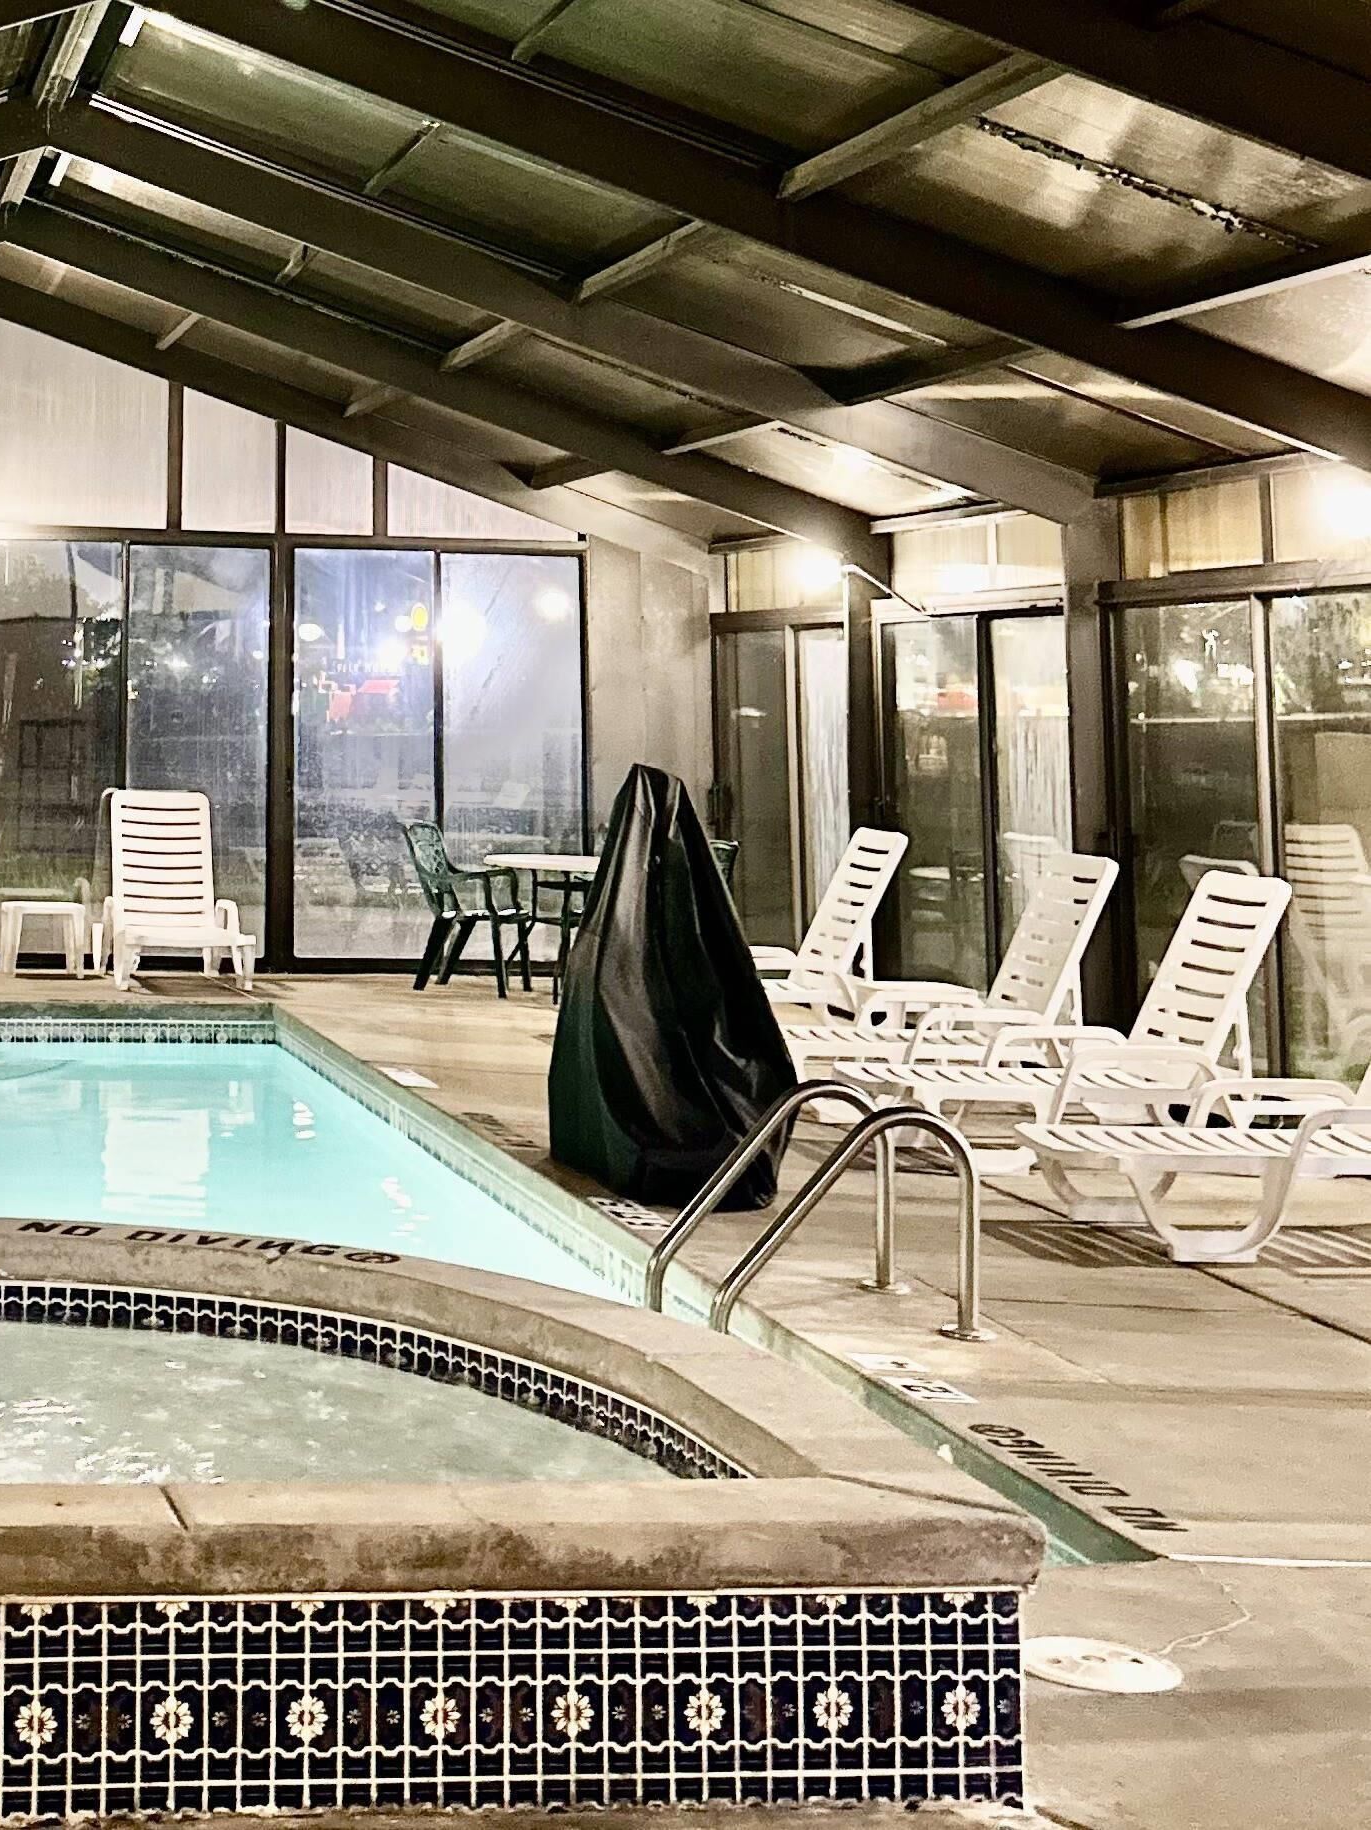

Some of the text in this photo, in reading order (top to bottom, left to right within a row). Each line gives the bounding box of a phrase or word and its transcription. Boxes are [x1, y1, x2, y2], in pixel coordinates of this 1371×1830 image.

[18, 1222, 342, 1256] NO DIVING
[987, 1439, 1189, 1533] NO DIVING
